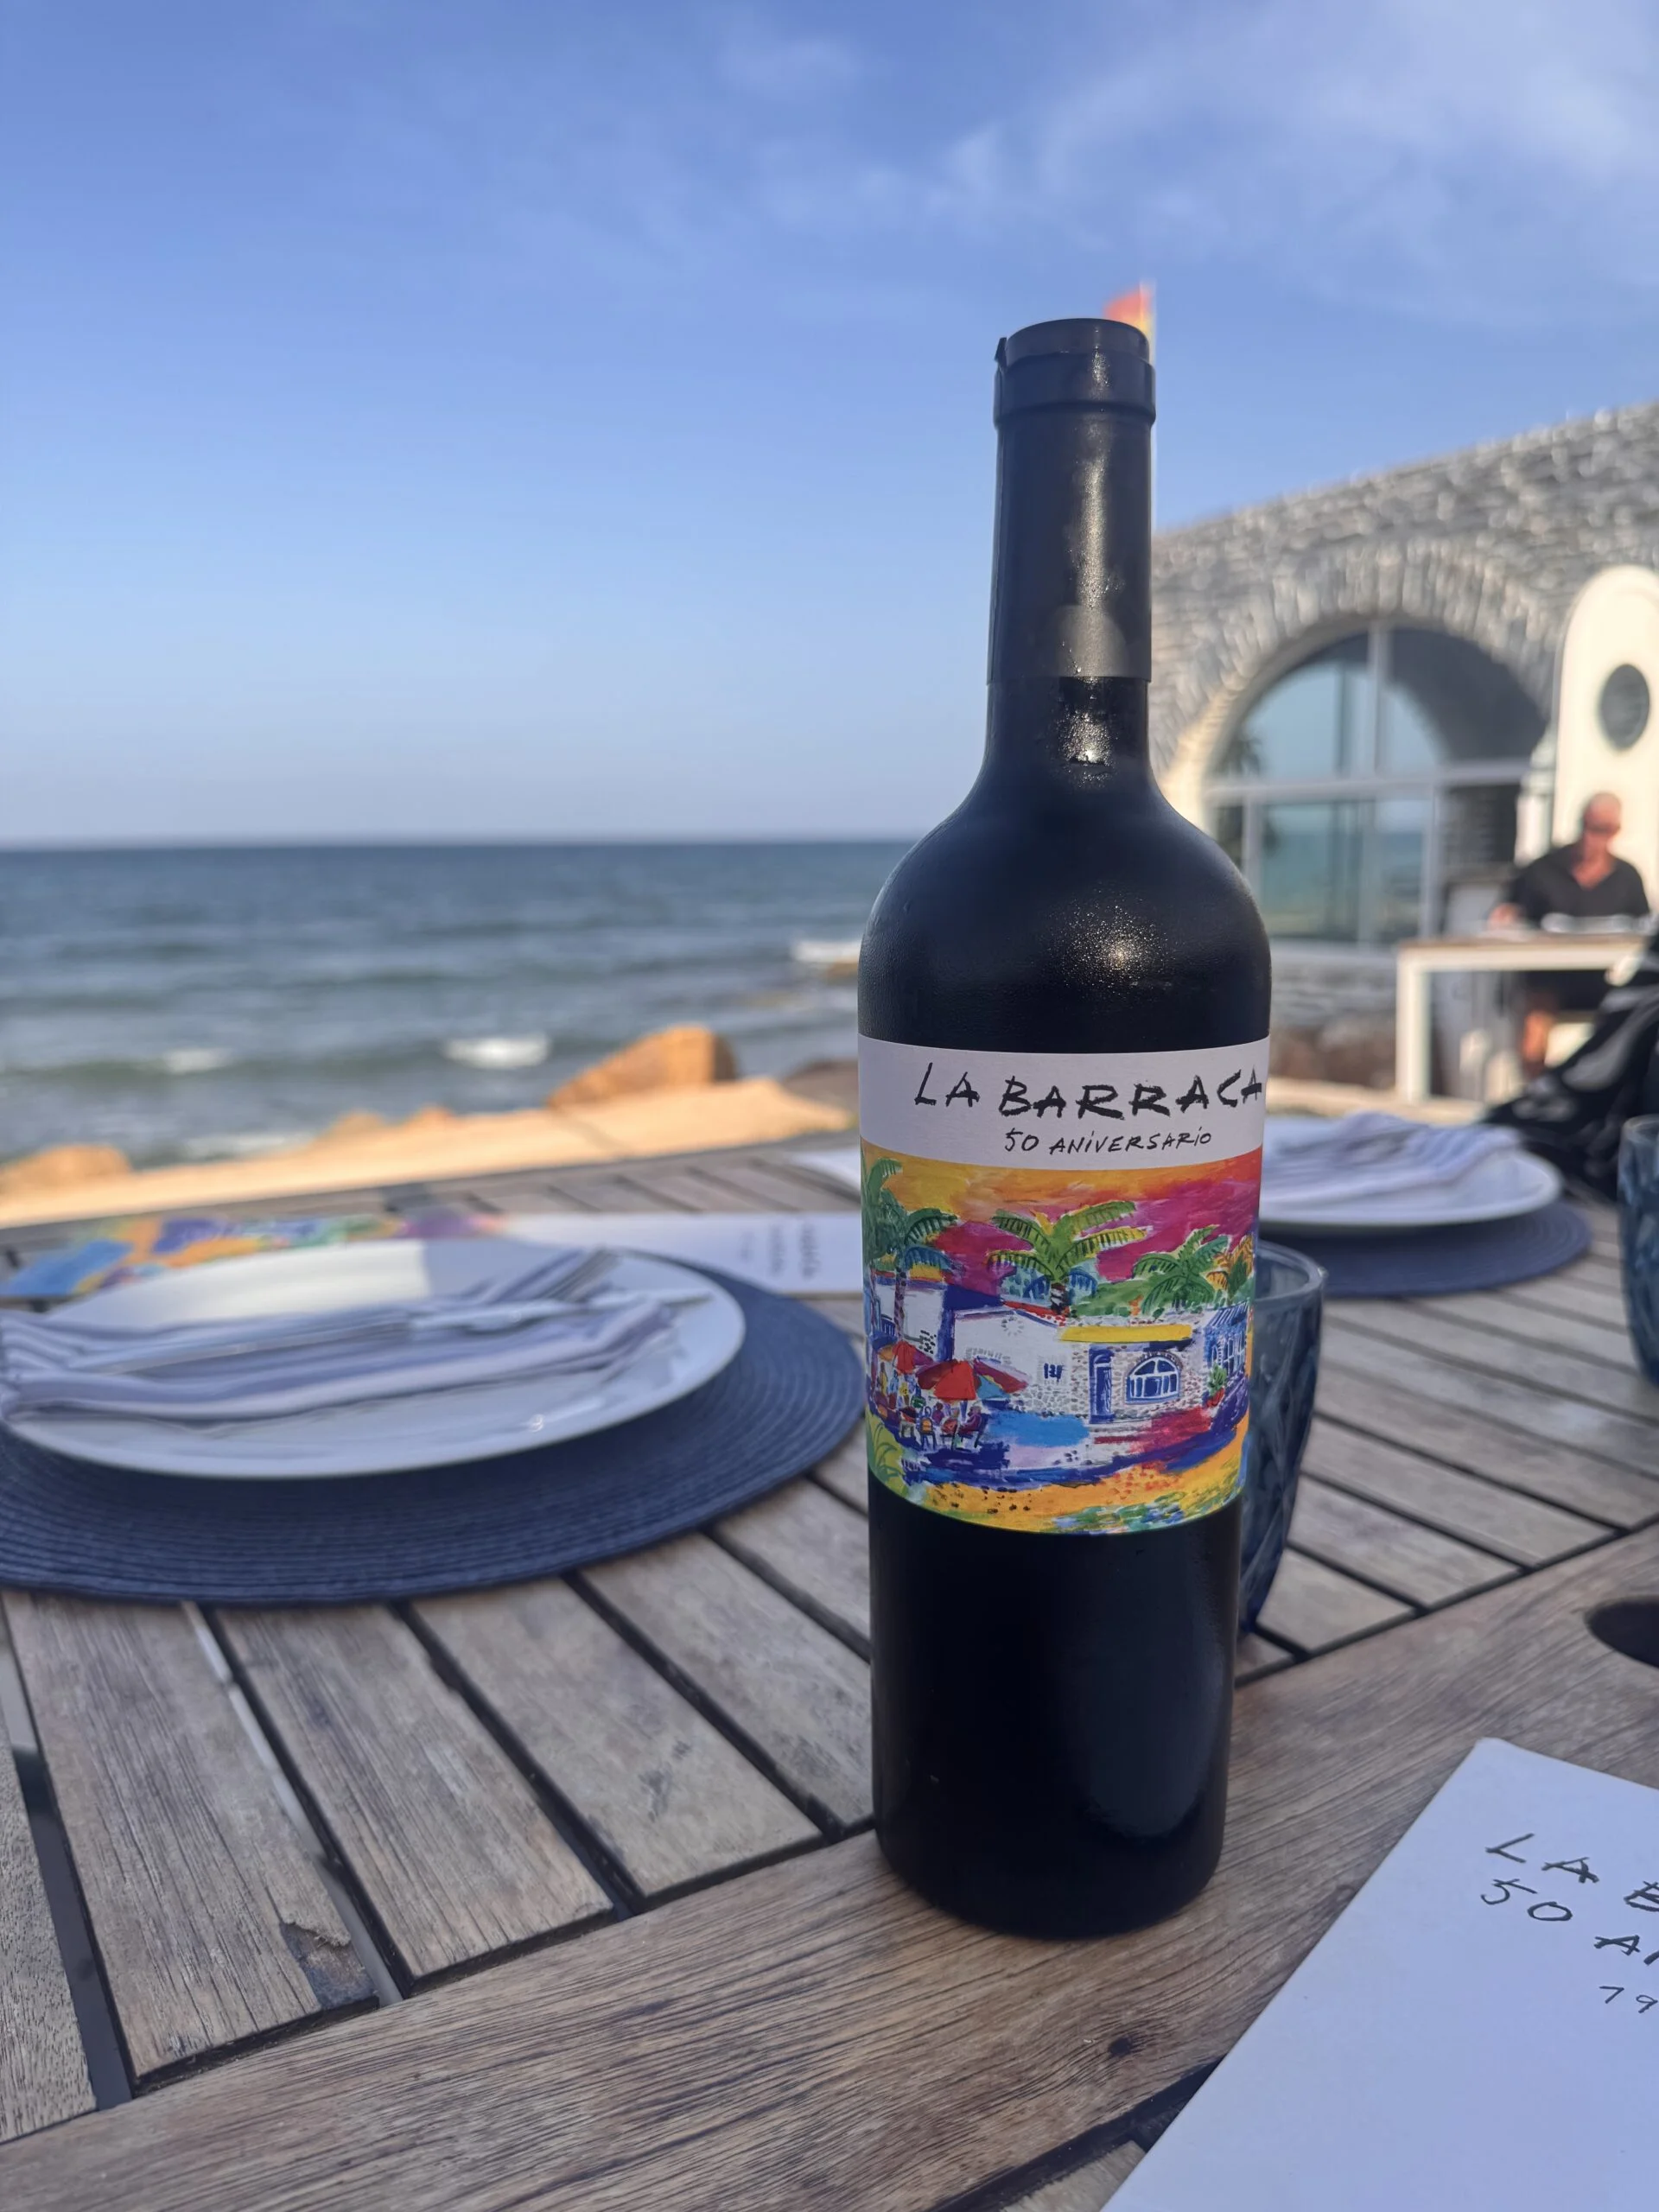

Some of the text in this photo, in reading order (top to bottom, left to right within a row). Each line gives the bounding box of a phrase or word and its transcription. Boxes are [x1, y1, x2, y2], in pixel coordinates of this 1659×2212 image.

[913, 1062, 1262, 1121] LA BARRACA
[1004, 1127, 1039, 1152] 50
[1485, 1833, 1599, 1884] LA
[1480, 1878, 1573, 1922] 50
